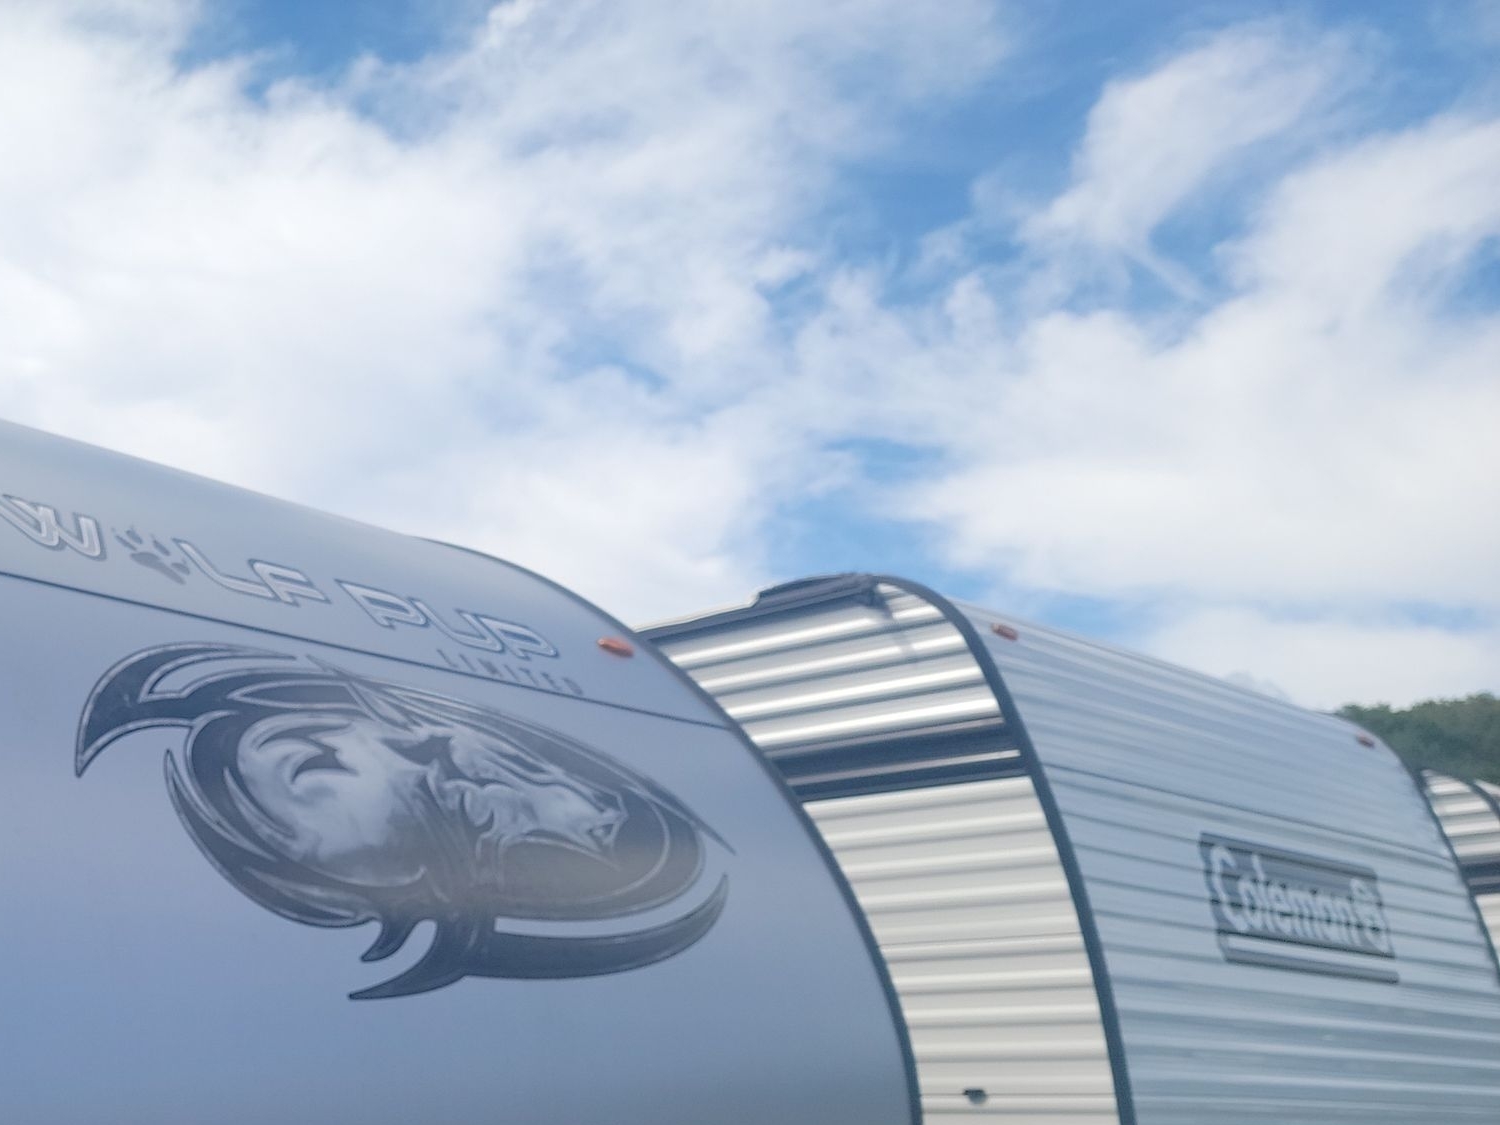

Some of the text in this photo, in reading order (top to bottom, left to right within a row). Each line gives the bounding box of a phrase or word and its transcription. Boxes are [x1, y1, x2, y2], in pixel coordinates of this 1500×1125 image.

[334, 578, 561, 662] PUP
[436, 648, 584, 696] LIMITED
[1210, 845, 1364, 947] Coleman
